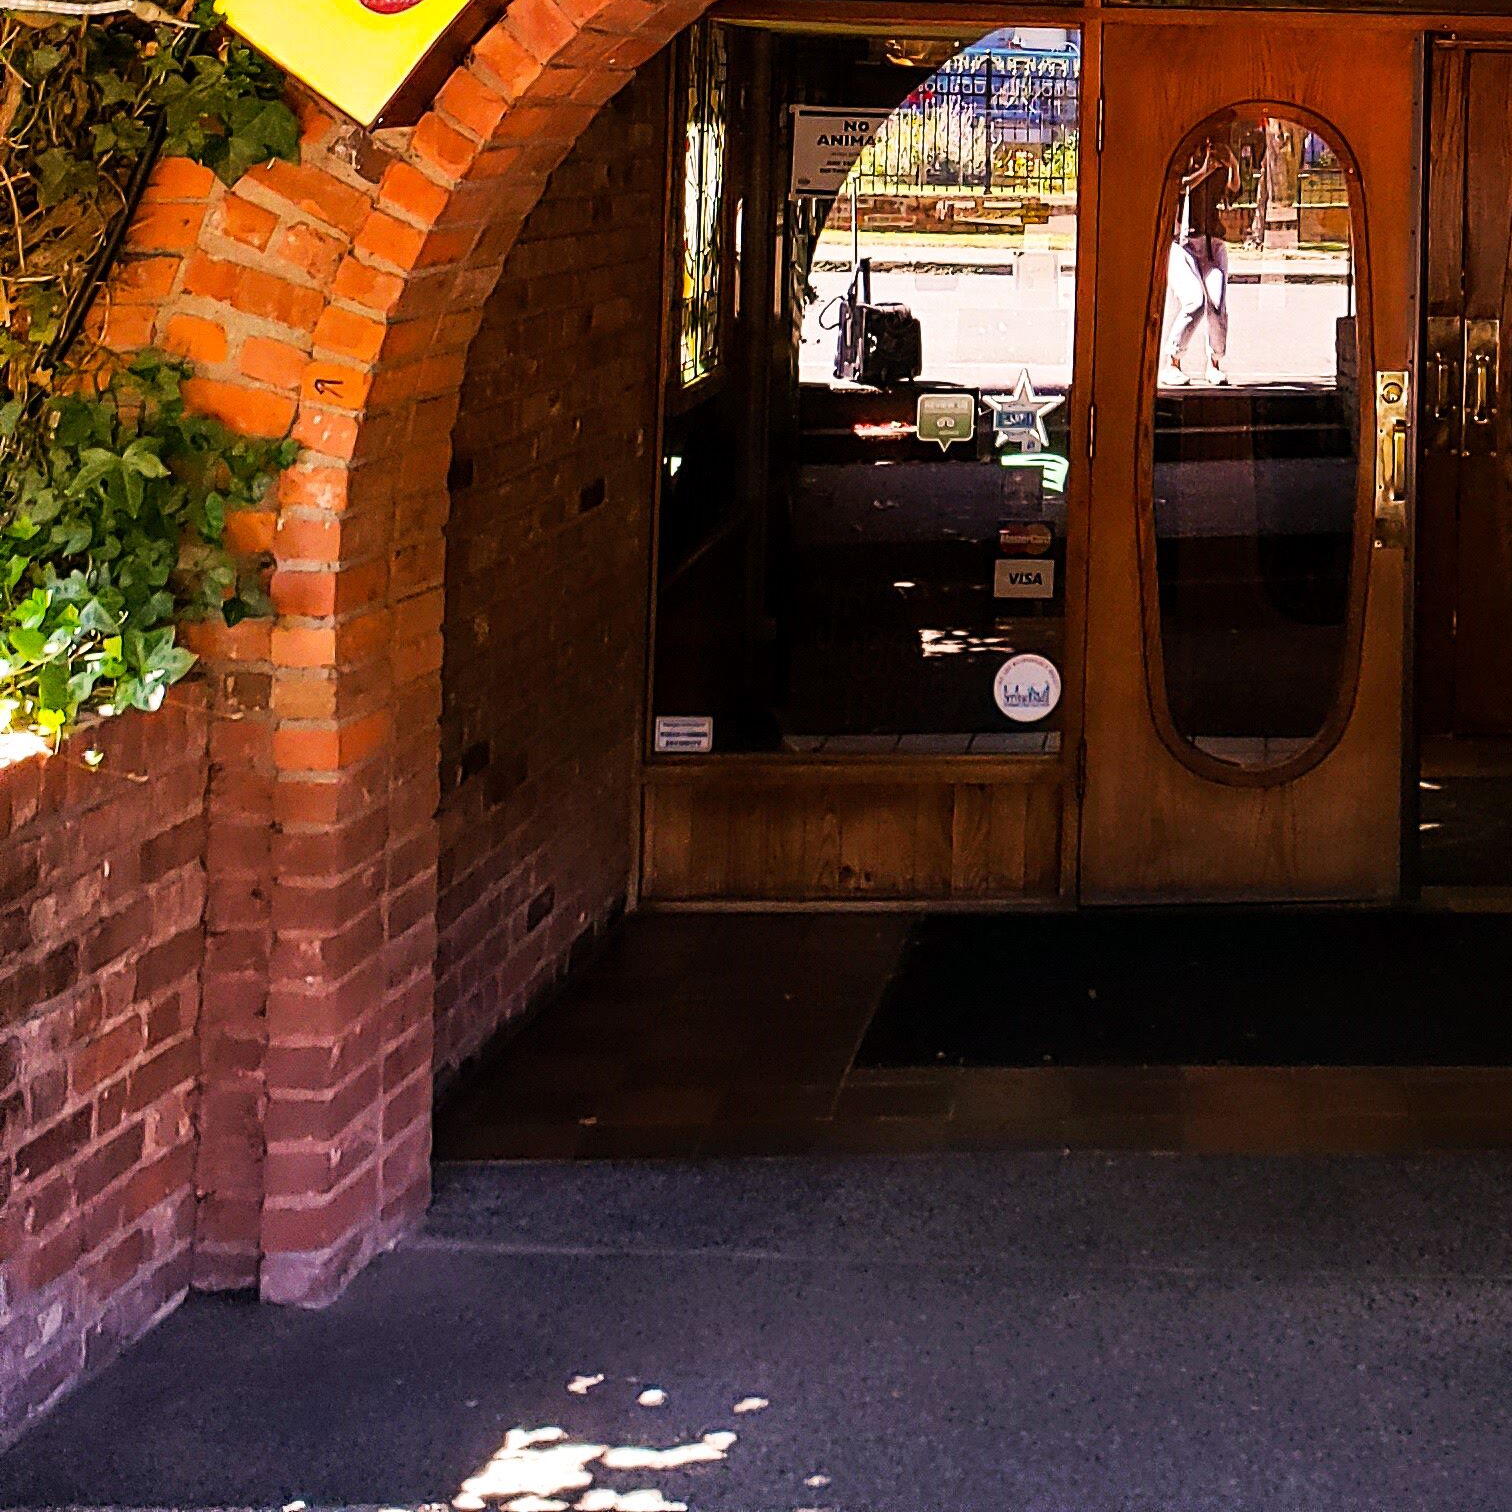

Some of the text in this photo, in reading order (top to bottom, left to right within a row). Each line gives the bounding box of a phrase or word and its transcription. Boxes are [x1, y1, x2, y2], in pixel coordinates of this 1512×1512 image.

[843, 120, 870, 132] NO
[816, 134, 876, 147] ANIMA
[1008, 571, 1043, 586] VISA
